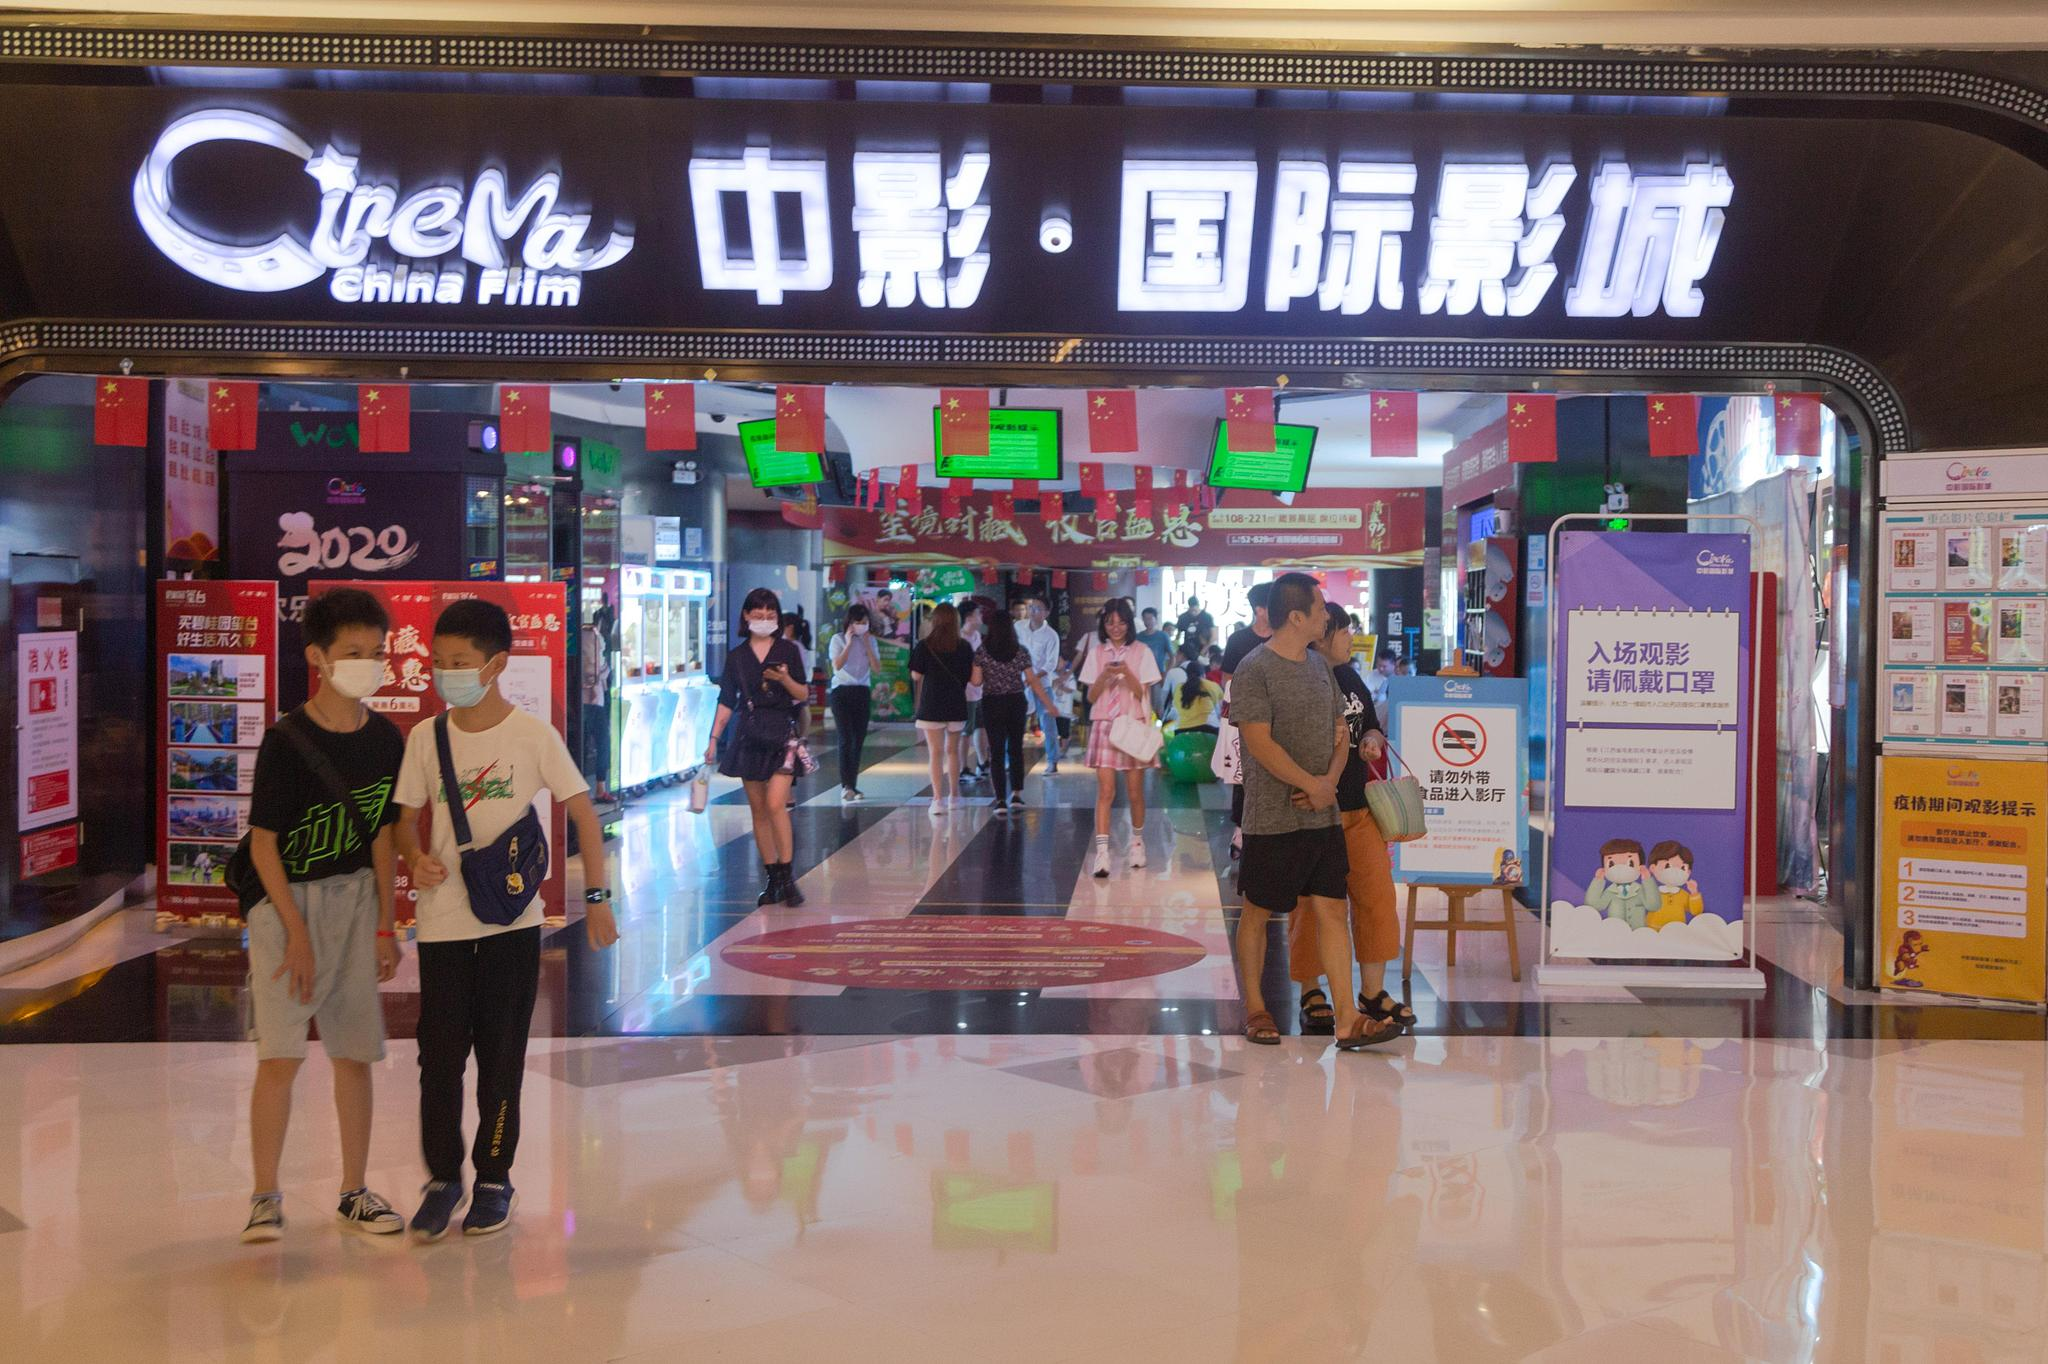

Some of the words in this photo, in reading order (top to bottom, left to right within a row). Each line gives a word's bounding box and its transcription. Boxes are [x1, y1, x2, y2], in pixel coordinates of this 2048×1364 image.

[329, 265, 464, 303] China
[477, 265, 581, 306] Film
[28, 646, 69, 673] 消火栓
[1587, 641, 1690, 666] 入场观影
[1586, 669, 1715, 694] 请佩戴口罩
[1429, 769, 1490, 786] 请勿外带
[1893, 794, 2037, 818] 疫情期间观影提示
[1903, 861, 1913, 877] 1
[1903, 886, 1915, 901] 2
[1903, 910, 1915, 926] 3
